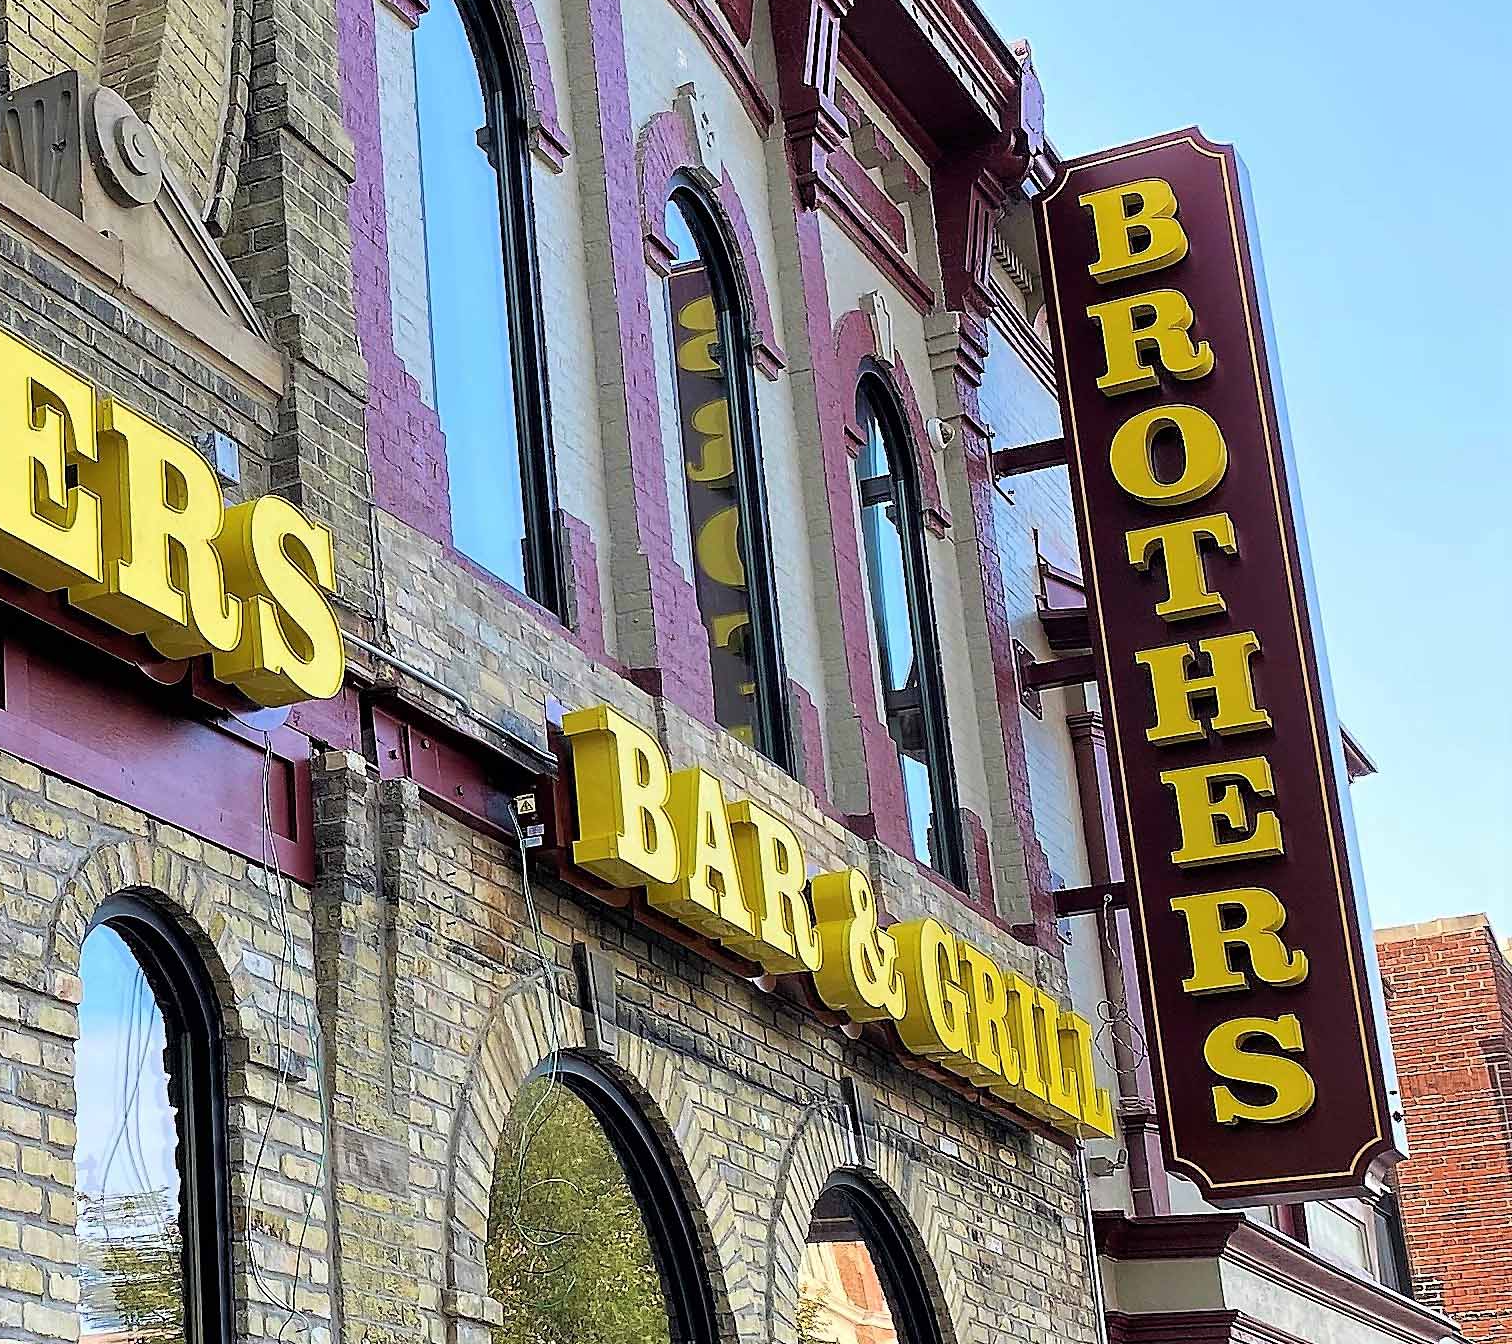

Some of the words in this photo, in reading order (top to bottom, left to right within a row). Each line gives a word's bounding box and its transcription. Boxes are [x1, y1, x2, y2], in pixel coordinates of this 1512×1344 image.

[562, 703, 824, 974] BAR
[810, 867, 908, 1023] &
[888, 916, 1116, 1140] GRILL
[1078, 176, 1321, 1127] BROTHERS
